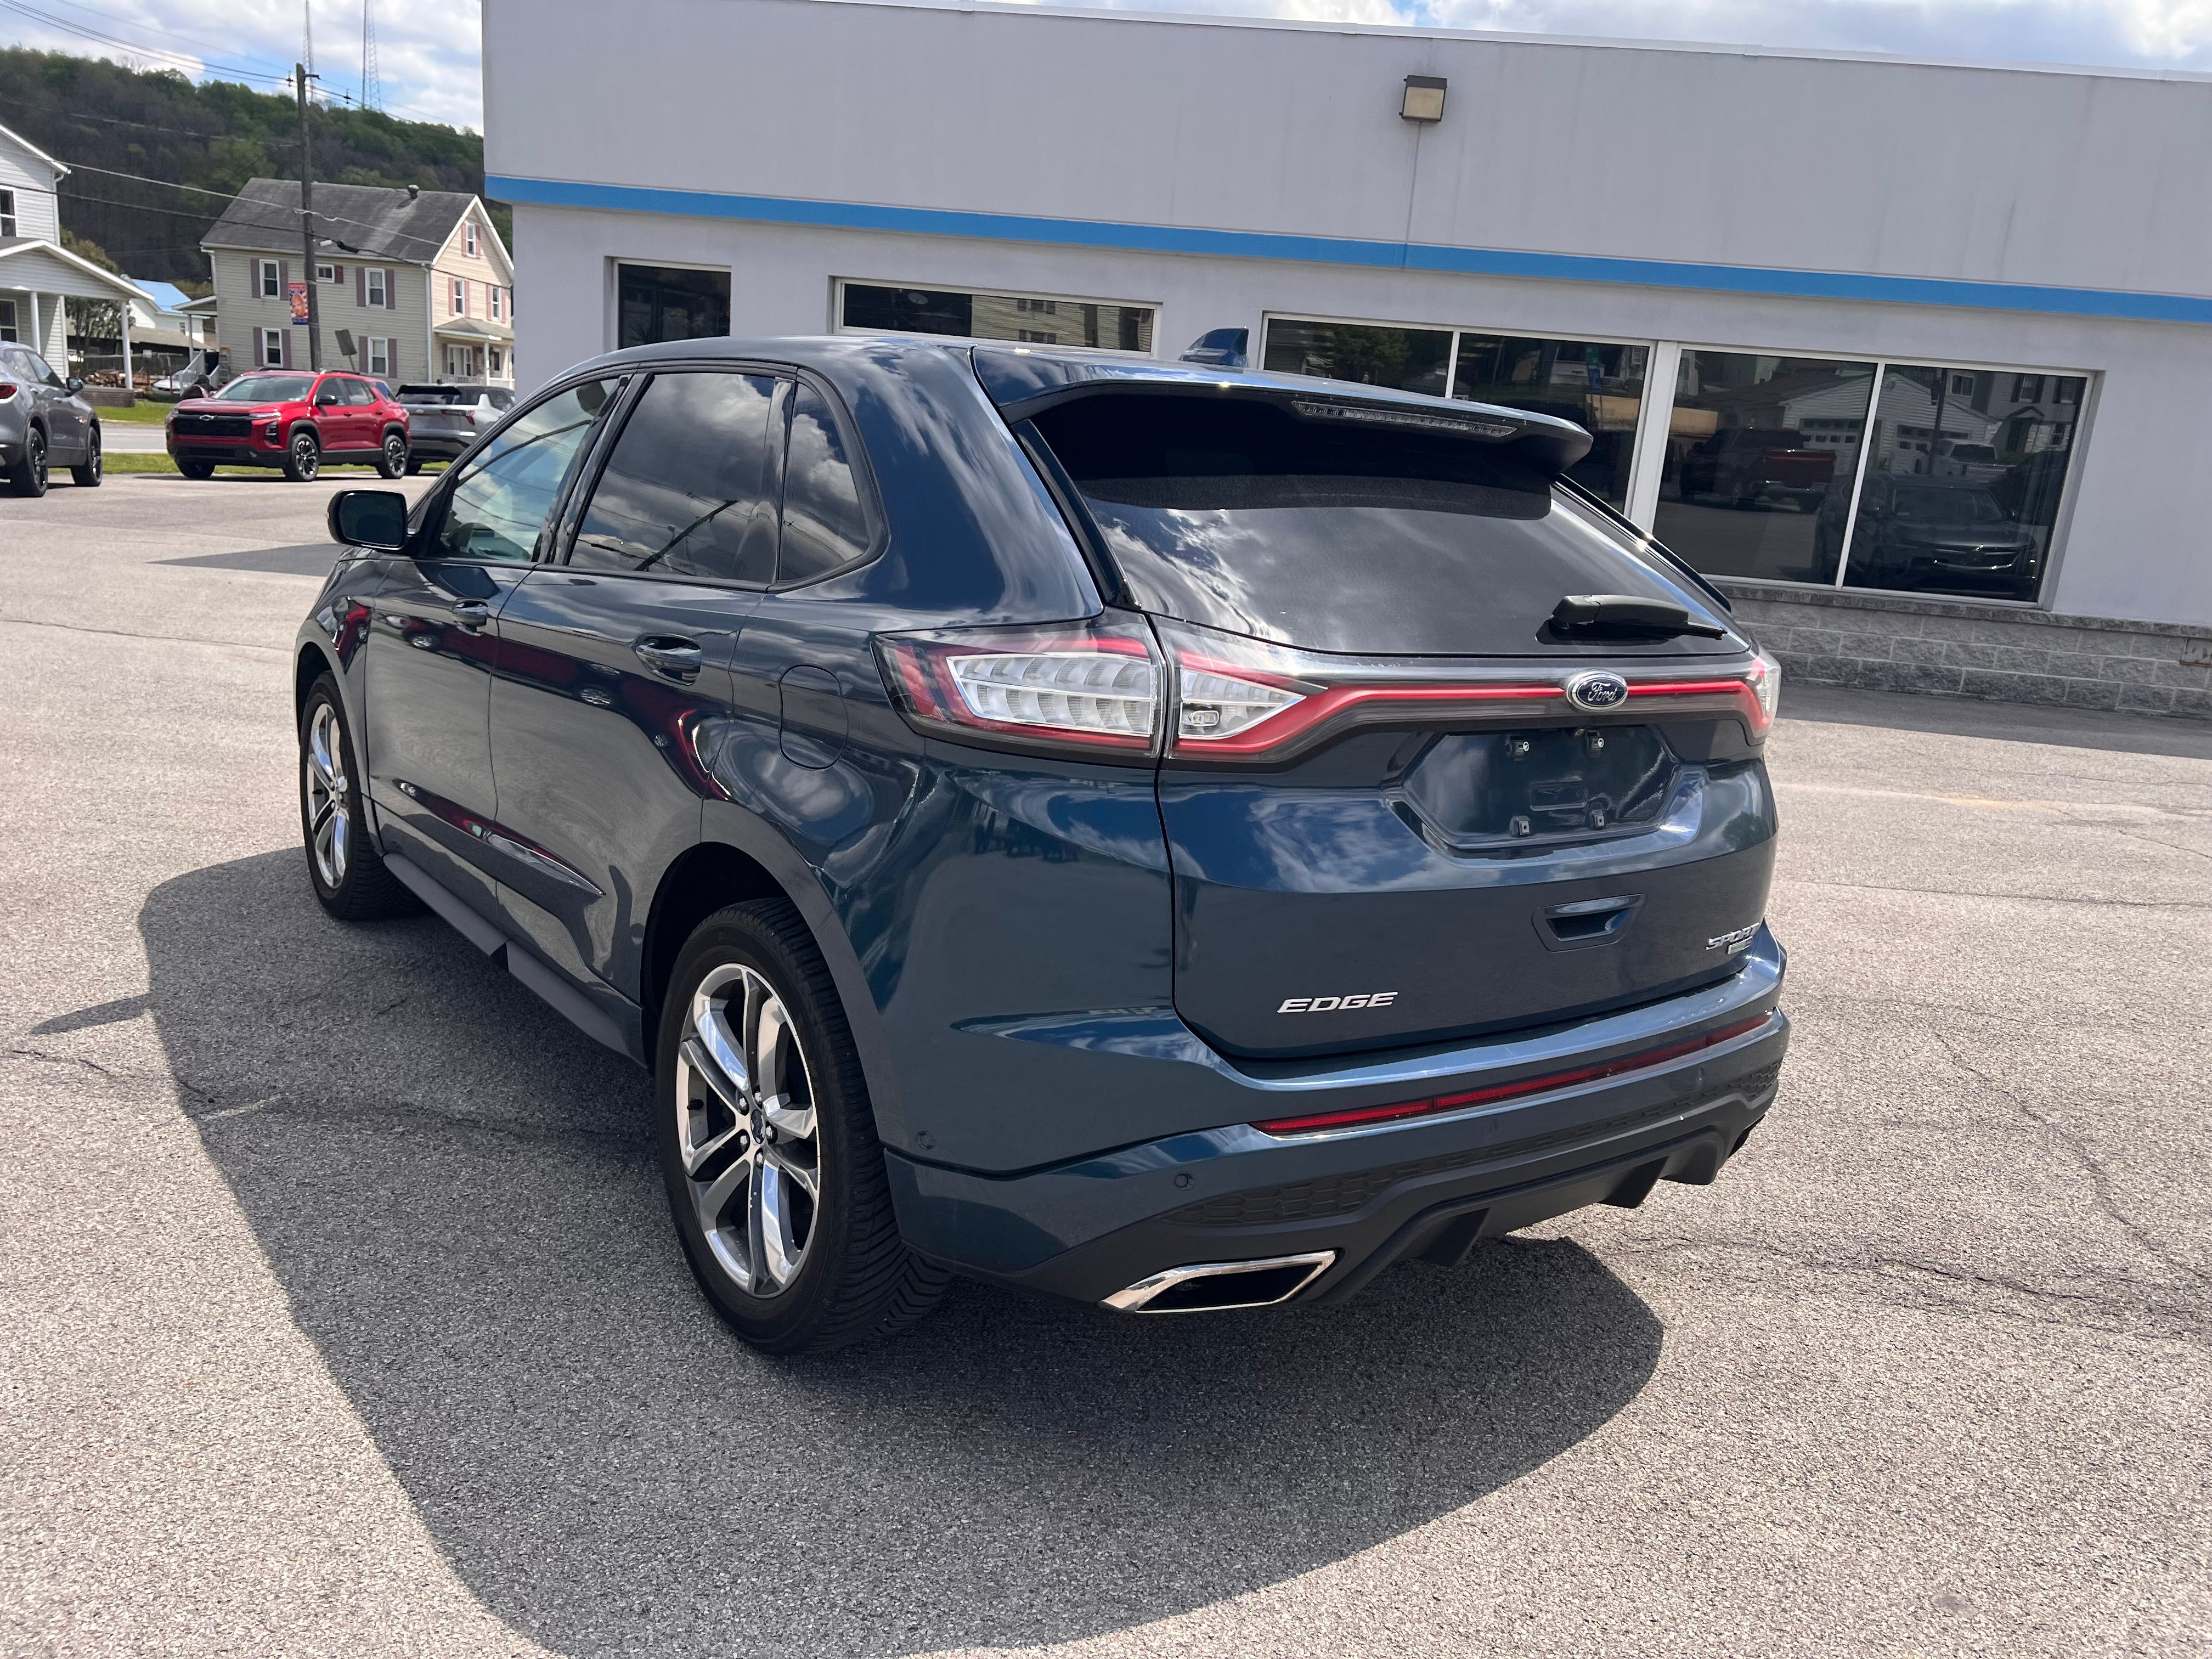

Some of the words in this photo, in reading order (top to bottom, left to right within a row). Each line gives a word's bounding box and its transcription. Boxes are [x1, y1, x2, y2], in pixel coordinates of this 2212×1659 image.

[1587, 682, 1618, 702] Ford
[1706, 922, 1760, 950] SPORT
[1277, 991, 1398, 1013] EDGE
